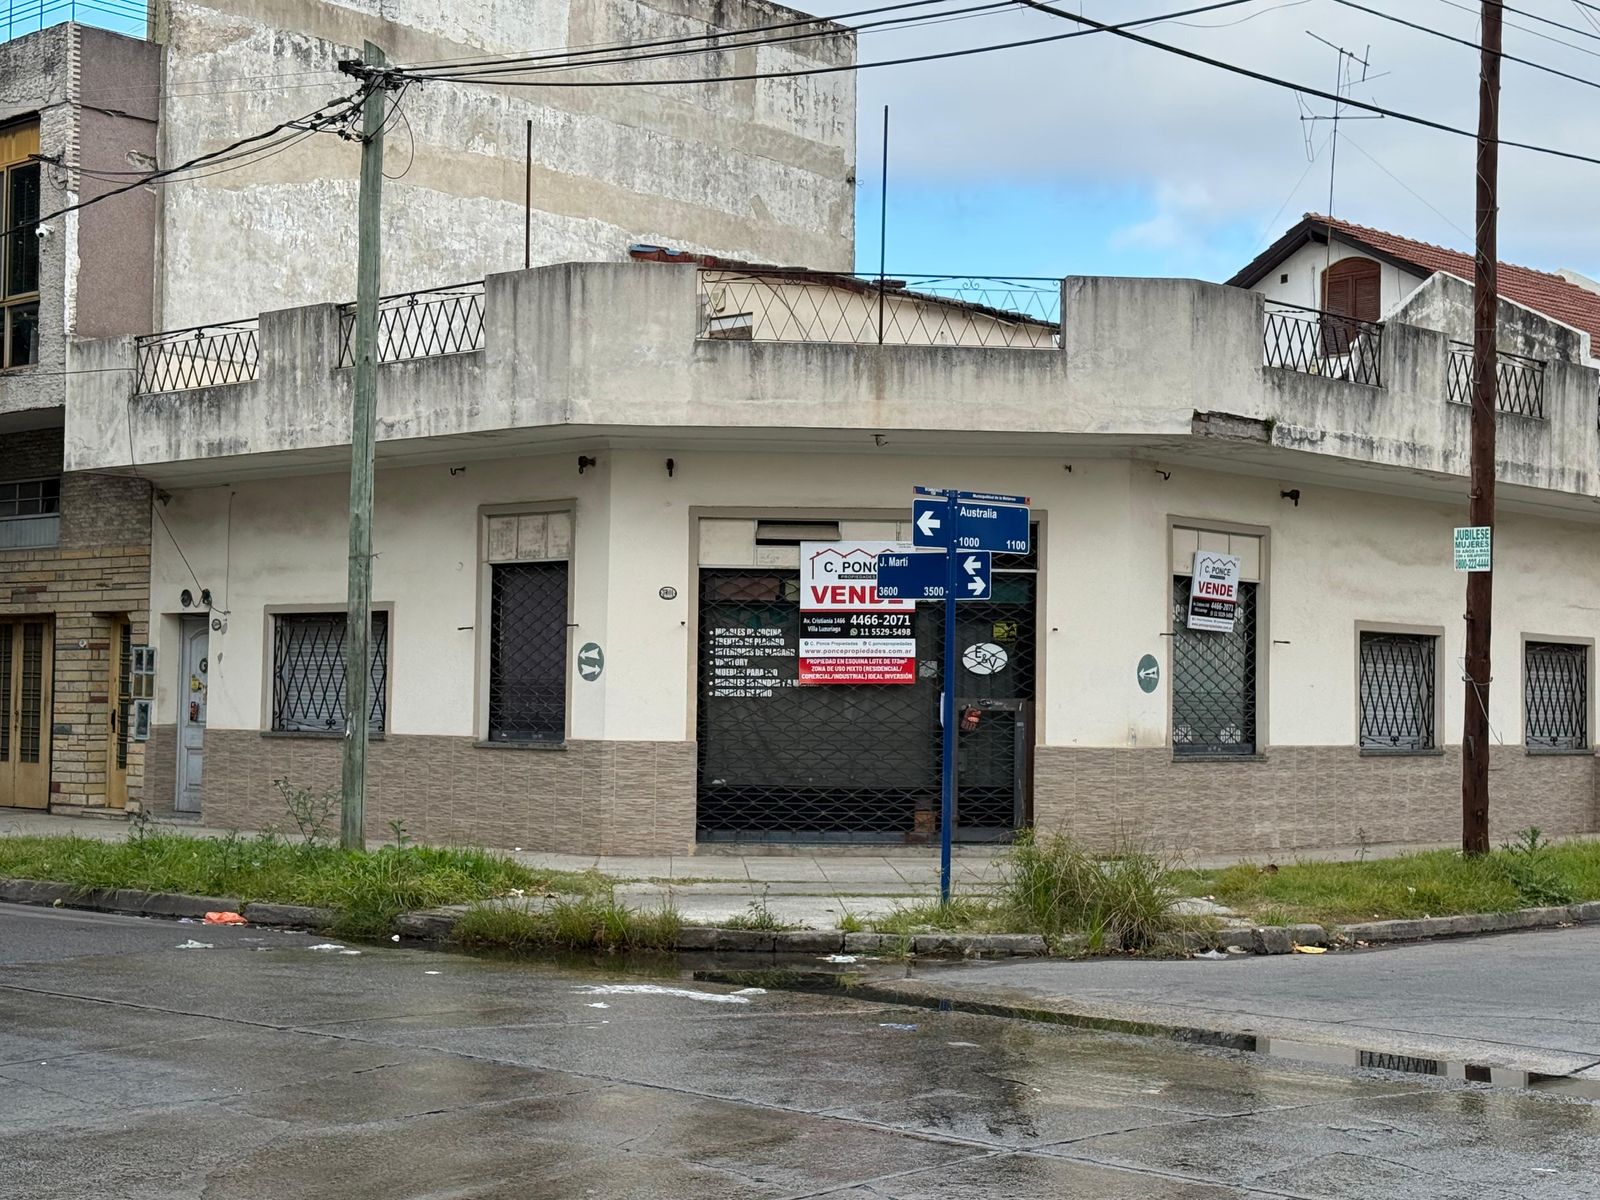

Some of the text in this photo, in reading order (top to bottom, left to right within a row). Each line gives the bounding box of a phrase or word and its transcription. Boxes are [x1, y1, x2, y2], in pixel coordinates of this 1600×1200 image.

[960, 506, 998, 519] Australia
[1455, 528, 1489, 540] JUBILESE
[959, 537, 1026, 550] 1000 1100
[824, 562, 838, 573] C.
[880, 558, 887, 566] J.
[1212, 566, 1231, 576] PONCE
[879, 586, 944, 596] 3600 3500
[1198, 581, 1234, 597] VENDE
[850, 615, 910, 625] 4466-2071
